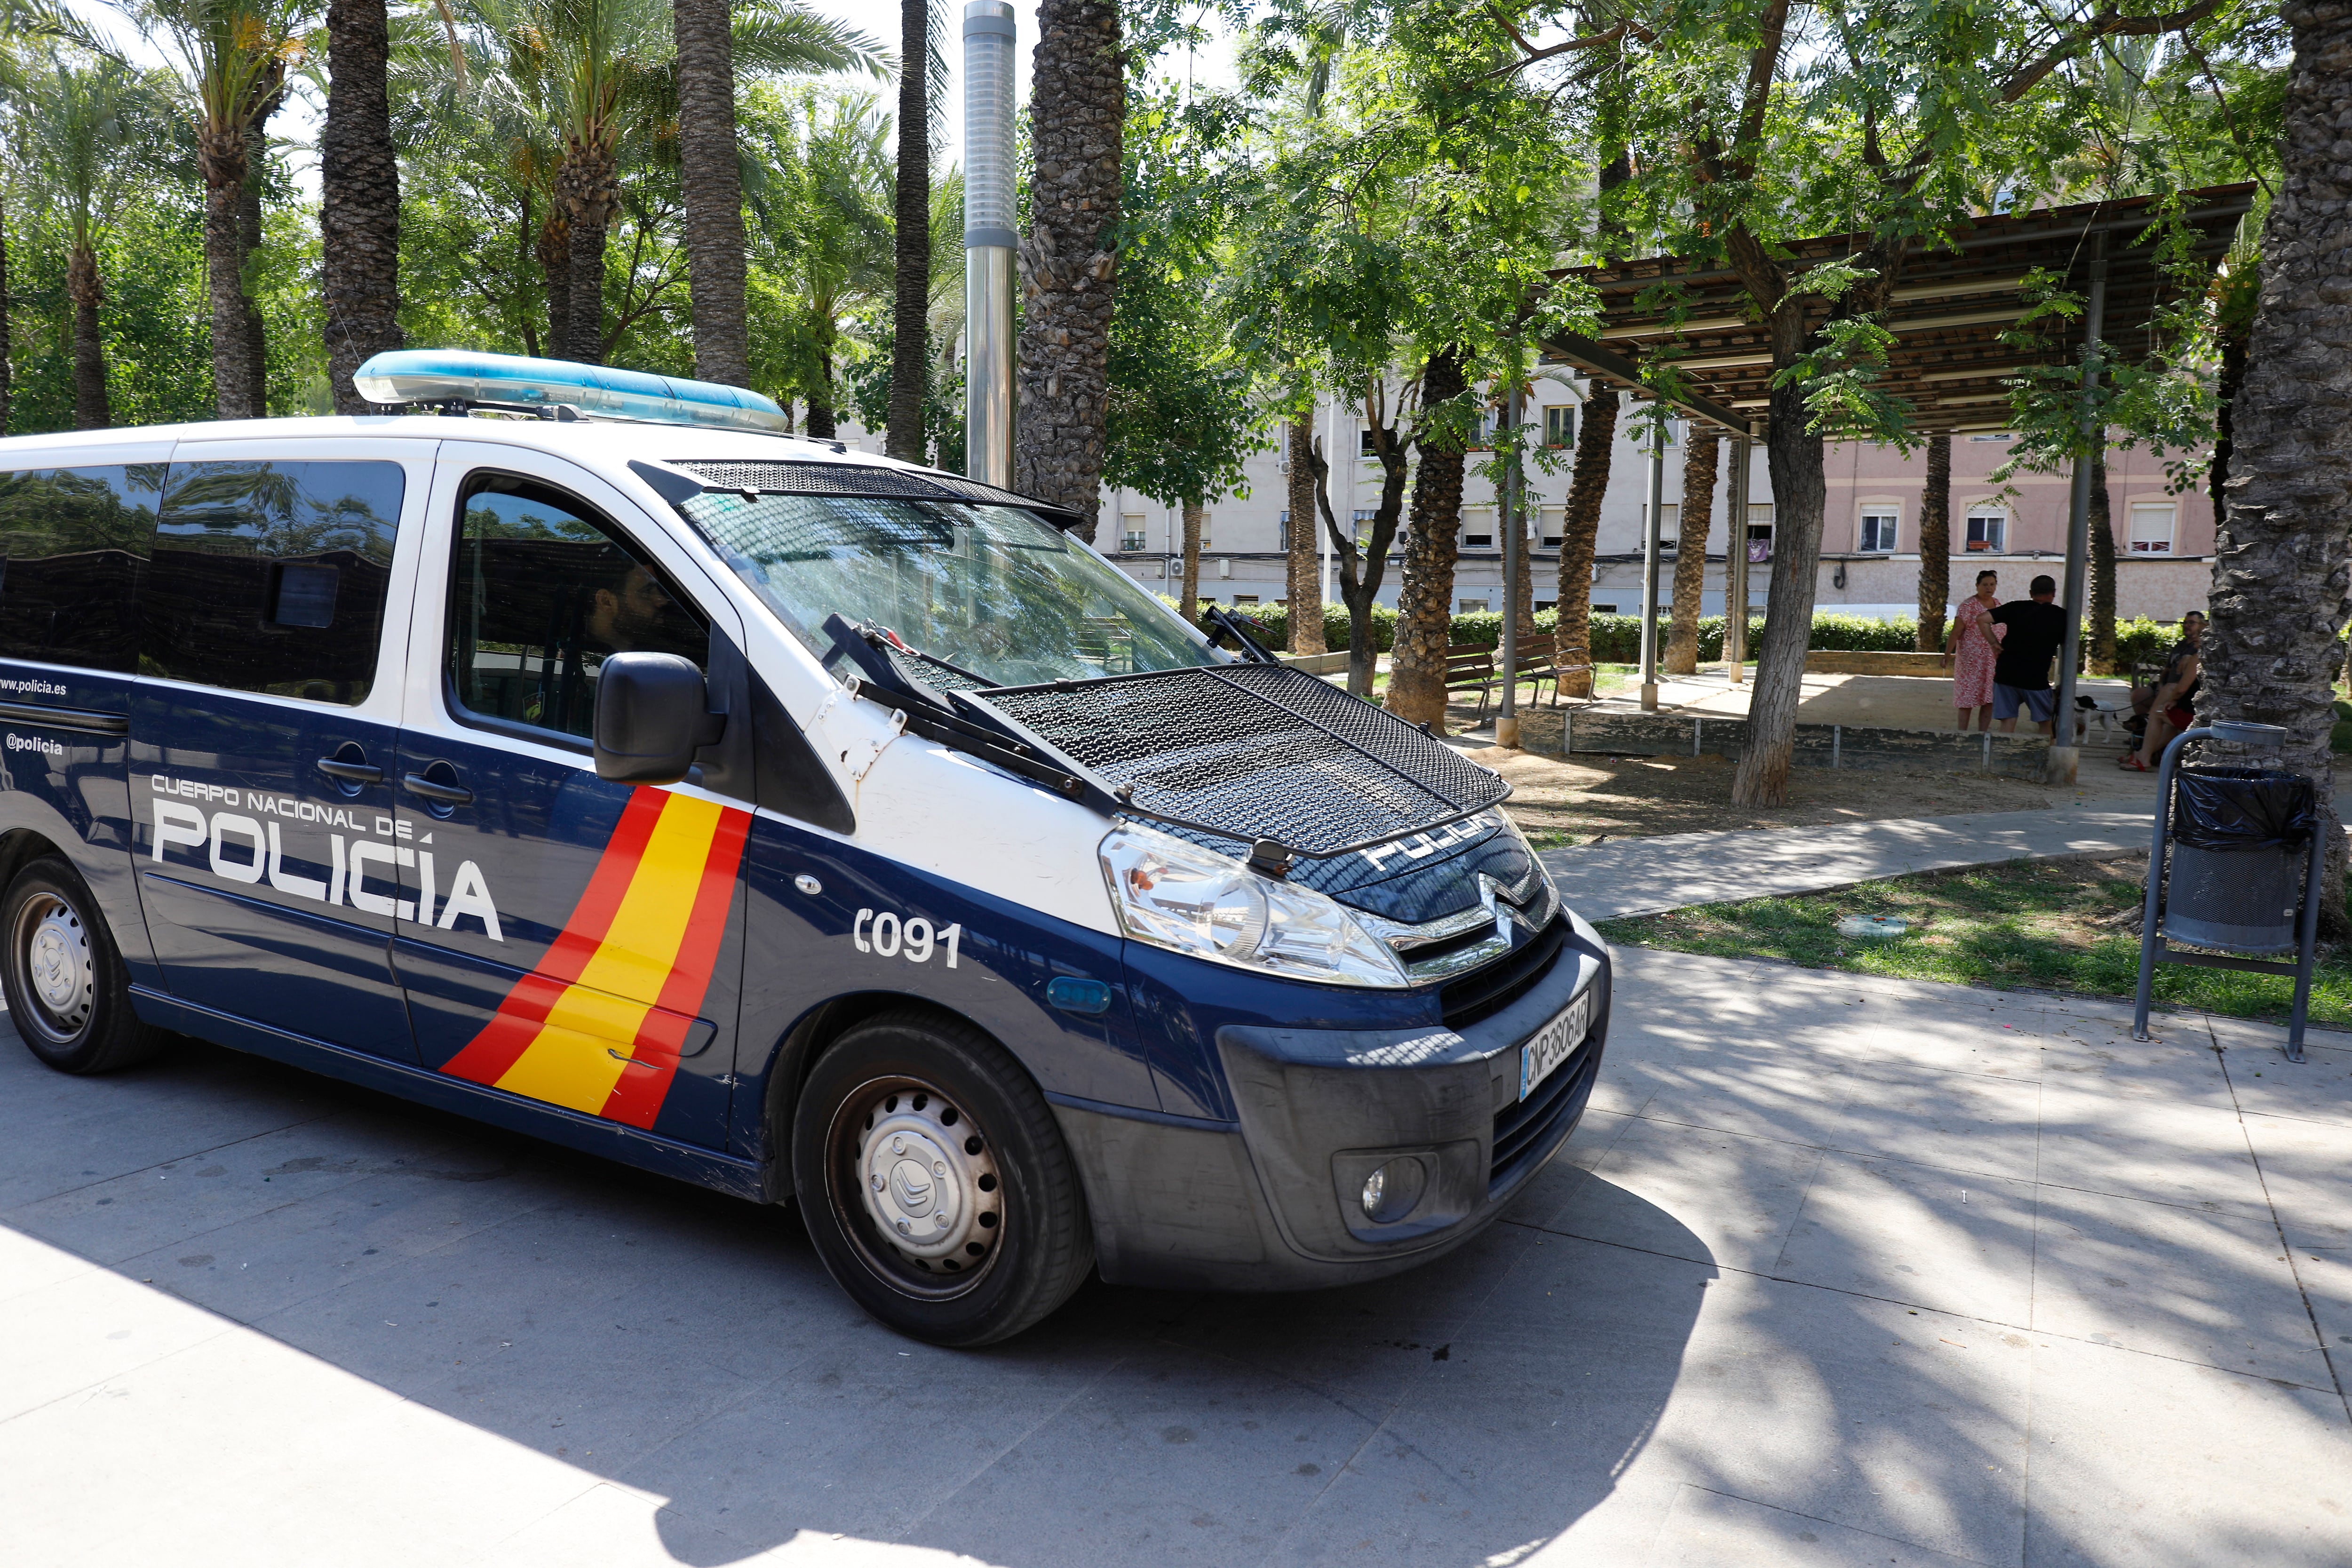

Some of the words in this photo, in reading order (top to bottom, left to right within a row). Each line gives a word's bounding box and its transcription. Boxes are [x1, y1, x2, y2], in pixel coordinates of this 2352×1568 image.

[0, 679, 66, 695] ww.policia.es
[7, 733, 63, 756] @policia
[151, 774, 239, 806] CUERPO
[247, 792, 366, 831] NACIONAL
[376, 815, 413, 840] DE
[152, 797, 504, 942] POLICÍA
[872, 911, 961, 969] 091
[1527, 1034, 1549, 1086] CNP
